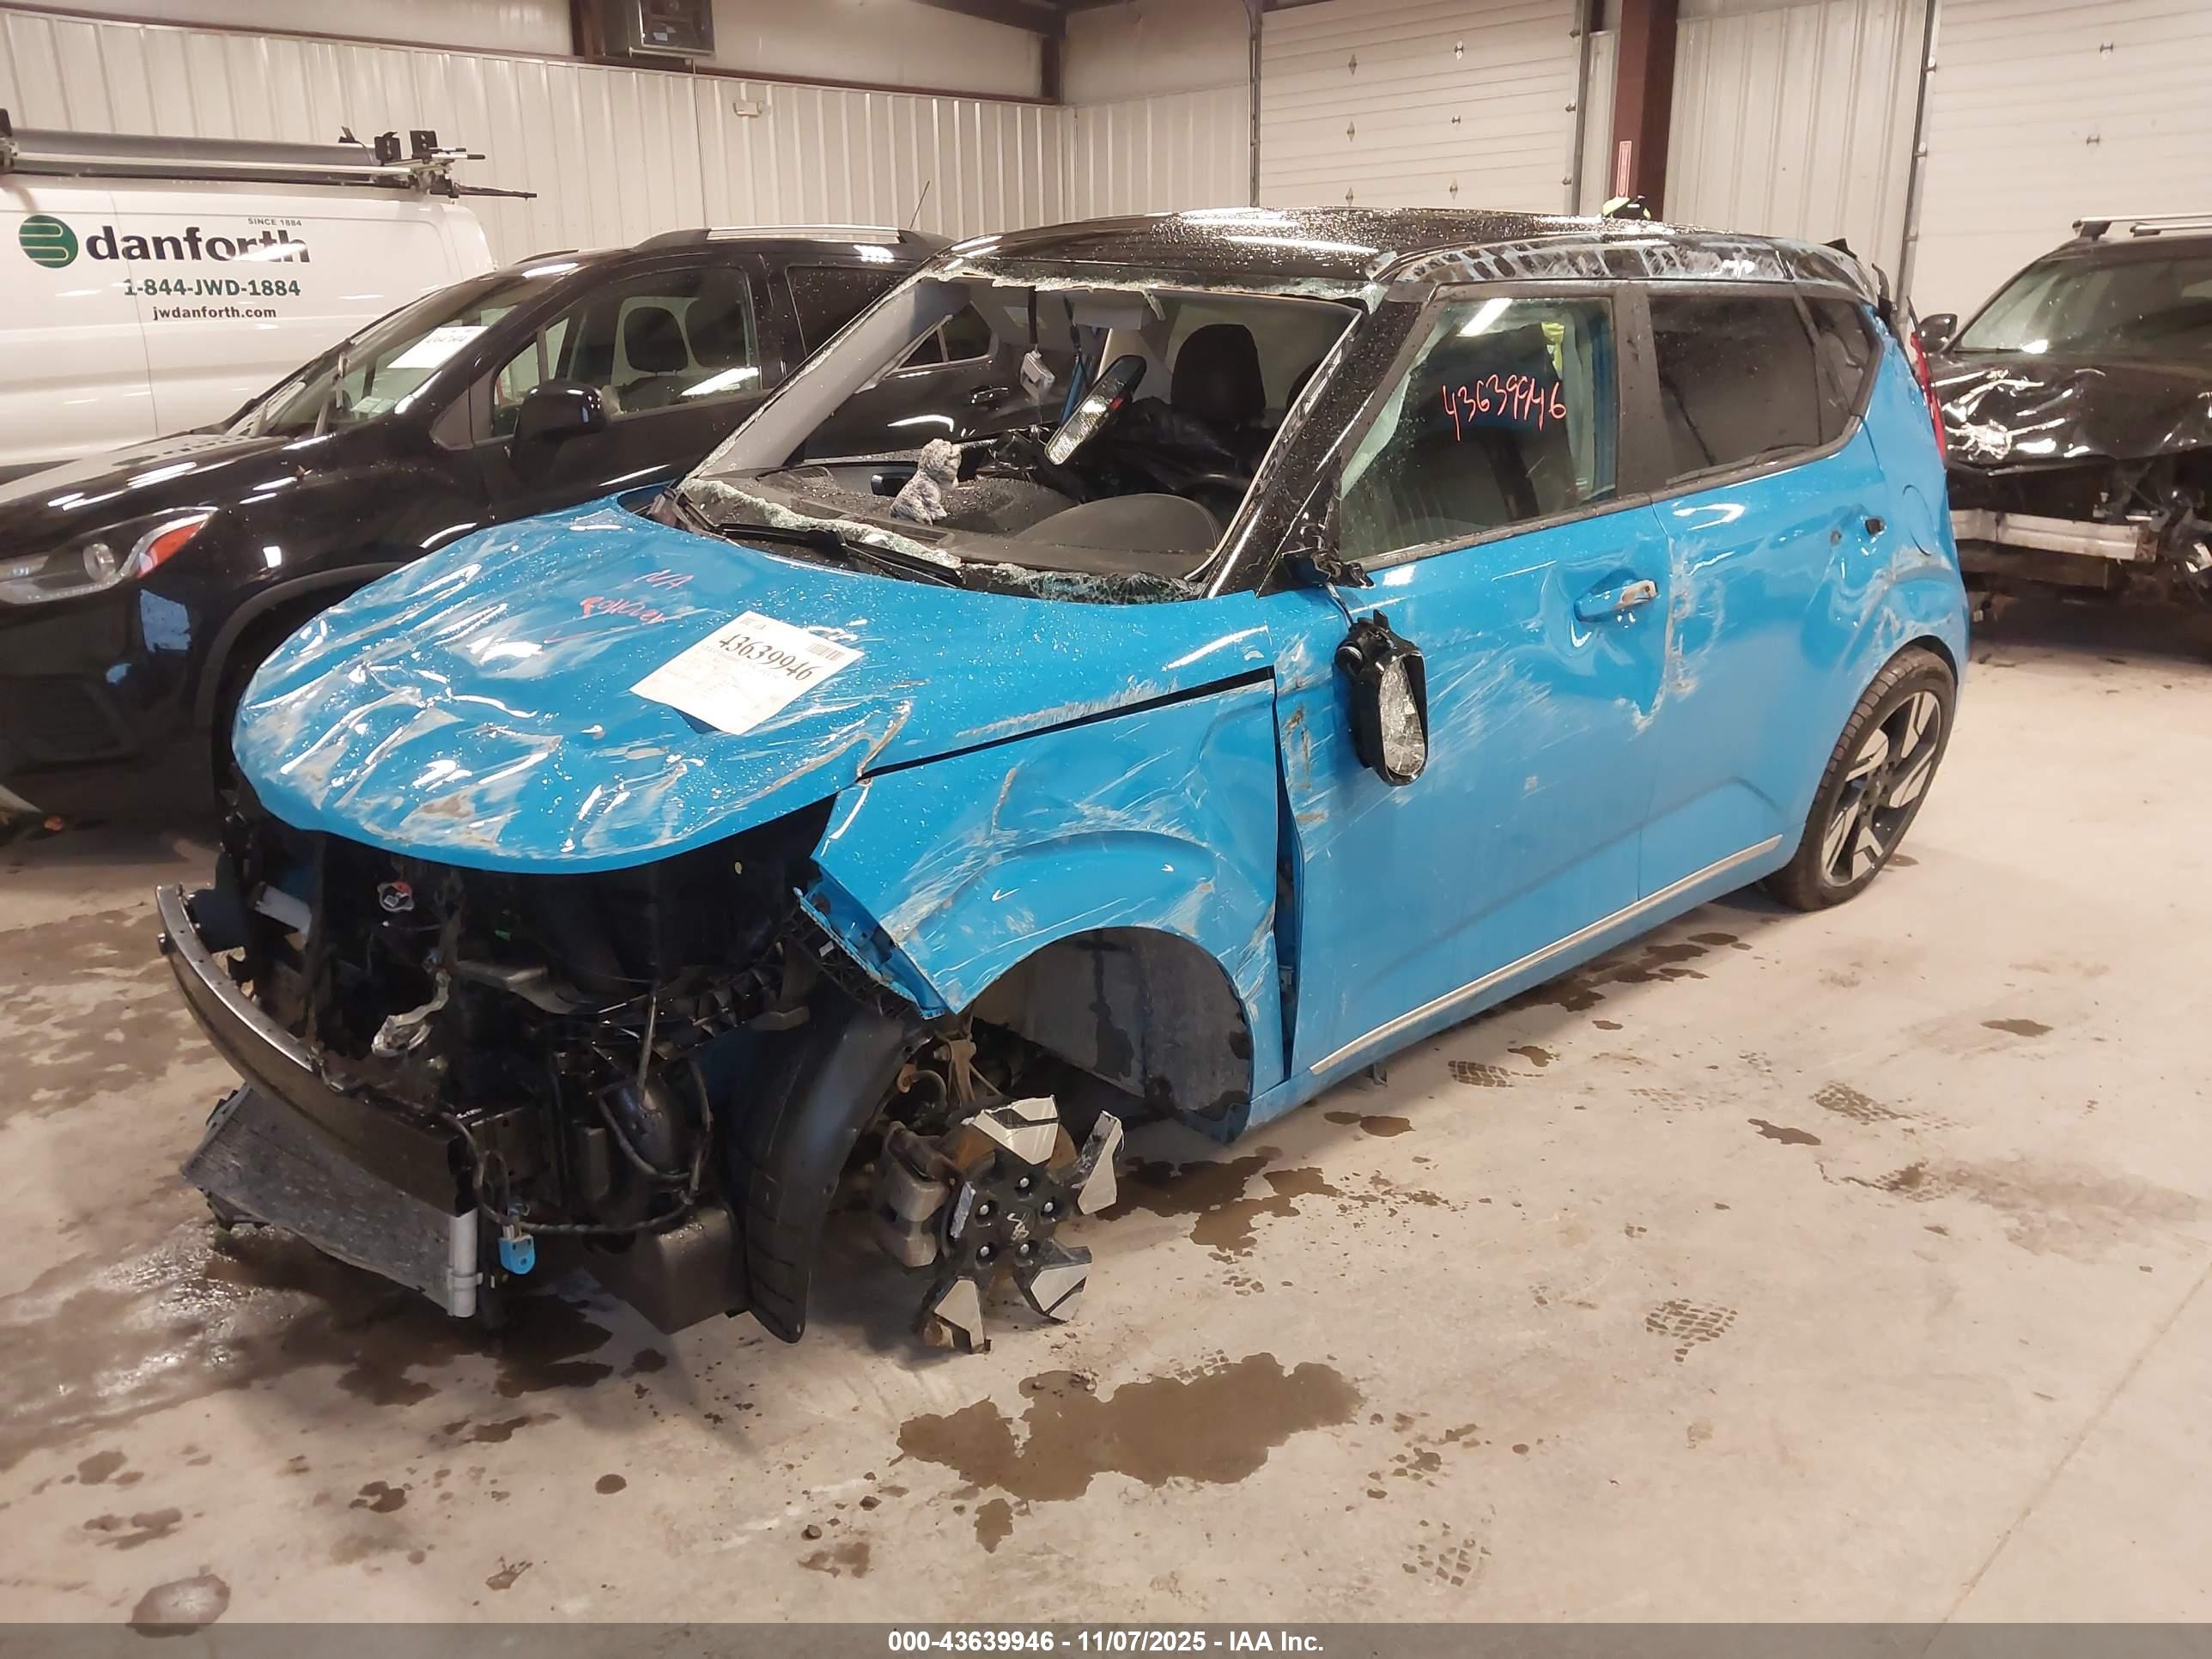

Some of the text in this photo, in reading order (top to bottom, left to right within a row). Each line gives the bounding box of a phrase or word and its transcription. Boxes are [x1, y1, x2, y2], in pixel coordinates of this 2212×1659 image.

[247, 217, 276, 226] SINCE
[85, 225, 310, 263] danforth
[123, 278, 301, 296] 1-844-JWD-1884
[152, 306, 277, 321] jwdanforth.com
[1442, 374, 1567, 441] 43639946
[718, 633, 823, 681] 43639946
